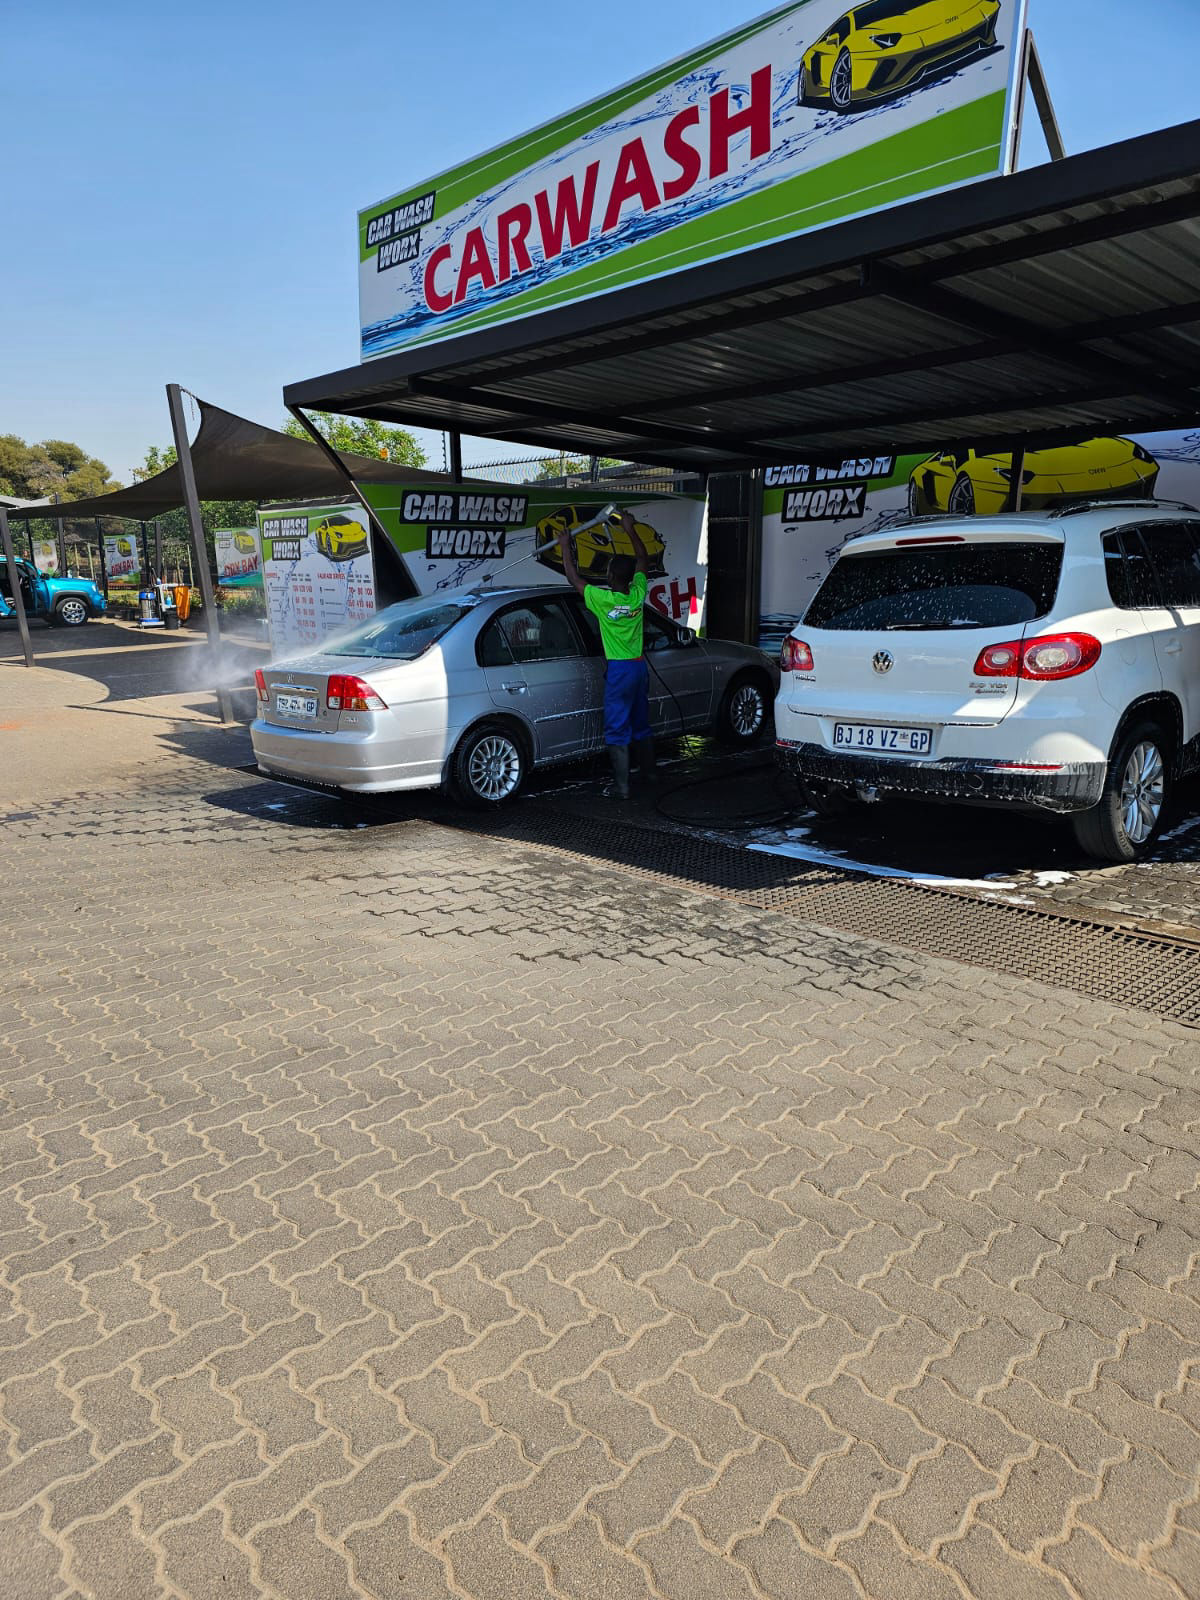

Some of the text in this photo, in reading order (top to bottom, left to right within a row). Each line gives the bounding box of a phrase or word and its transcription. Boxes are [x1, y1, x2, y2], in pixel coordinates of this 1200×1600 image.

[424, 63, 772, 313] CARWASH
[367, 194, 434, 245] CAR WASH
[379, 232, 419, 268] WORX
[403, 493, 526, 522] CAR WASH
[785, 487, 863, 519] WORX
[263, 517, 308, 538] CAR WASH
[272, 540, 300, 559] WORX
[430, 529, 503, 556] WORX
[124, 559, 135, 572] BAY
[242, 554, 259, 572] BAY
[306, 701, 315, 713] GP
[836, 726, 928, 750] BJ 18 VZ GP
